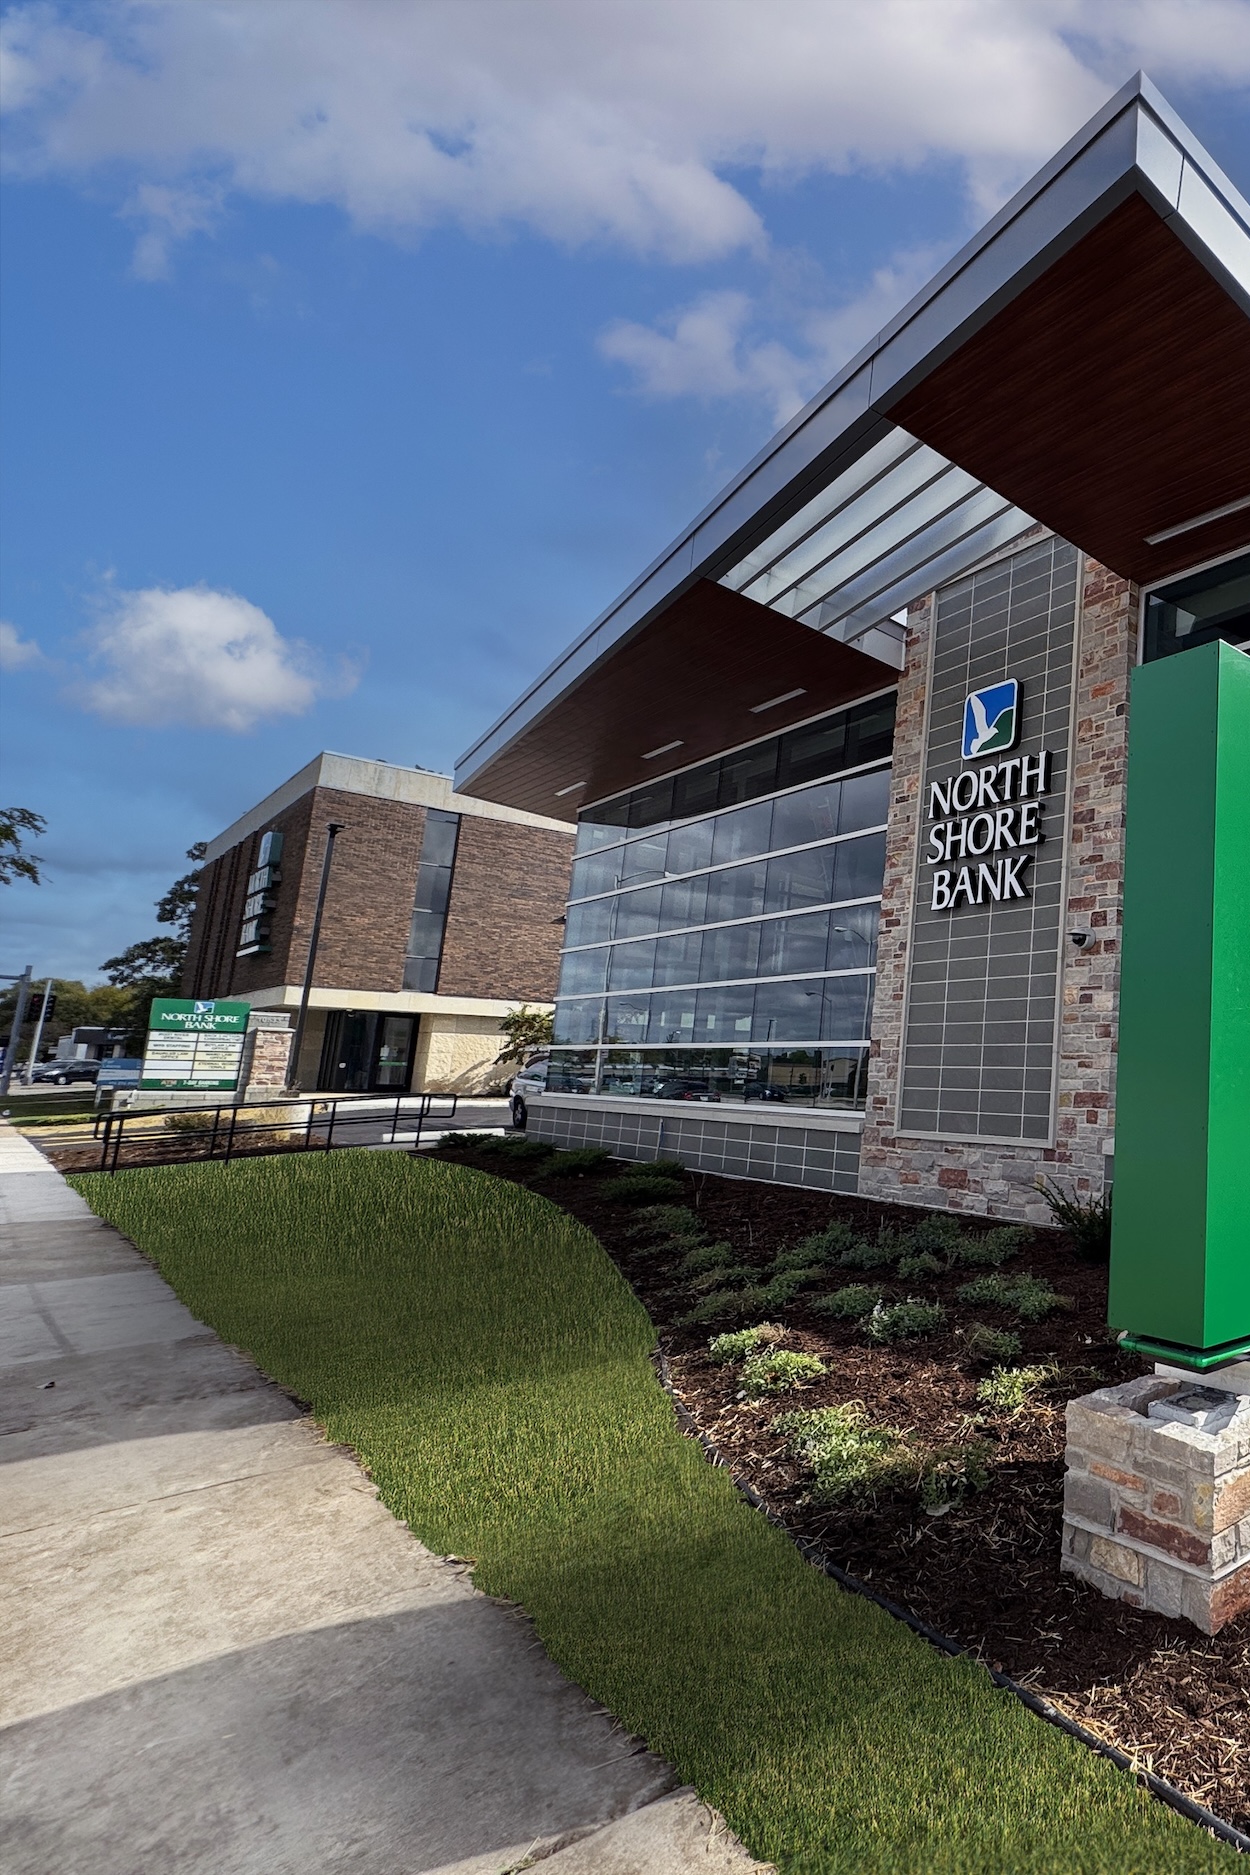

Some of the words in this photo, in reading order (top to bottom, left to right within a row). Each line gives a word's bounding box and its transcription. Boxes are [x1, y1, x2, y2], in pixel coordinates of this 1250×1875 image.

[928, 750, 1048, 819] NORTH
[927, 802, 1040, 864] SHORE
[931, 855, 1028, 911] BANK
[161, 1013, 202, 1022] NORTH
[204, 1014, 240, 1024] SHORE
[184, 1021, 216, 1030] BANK
